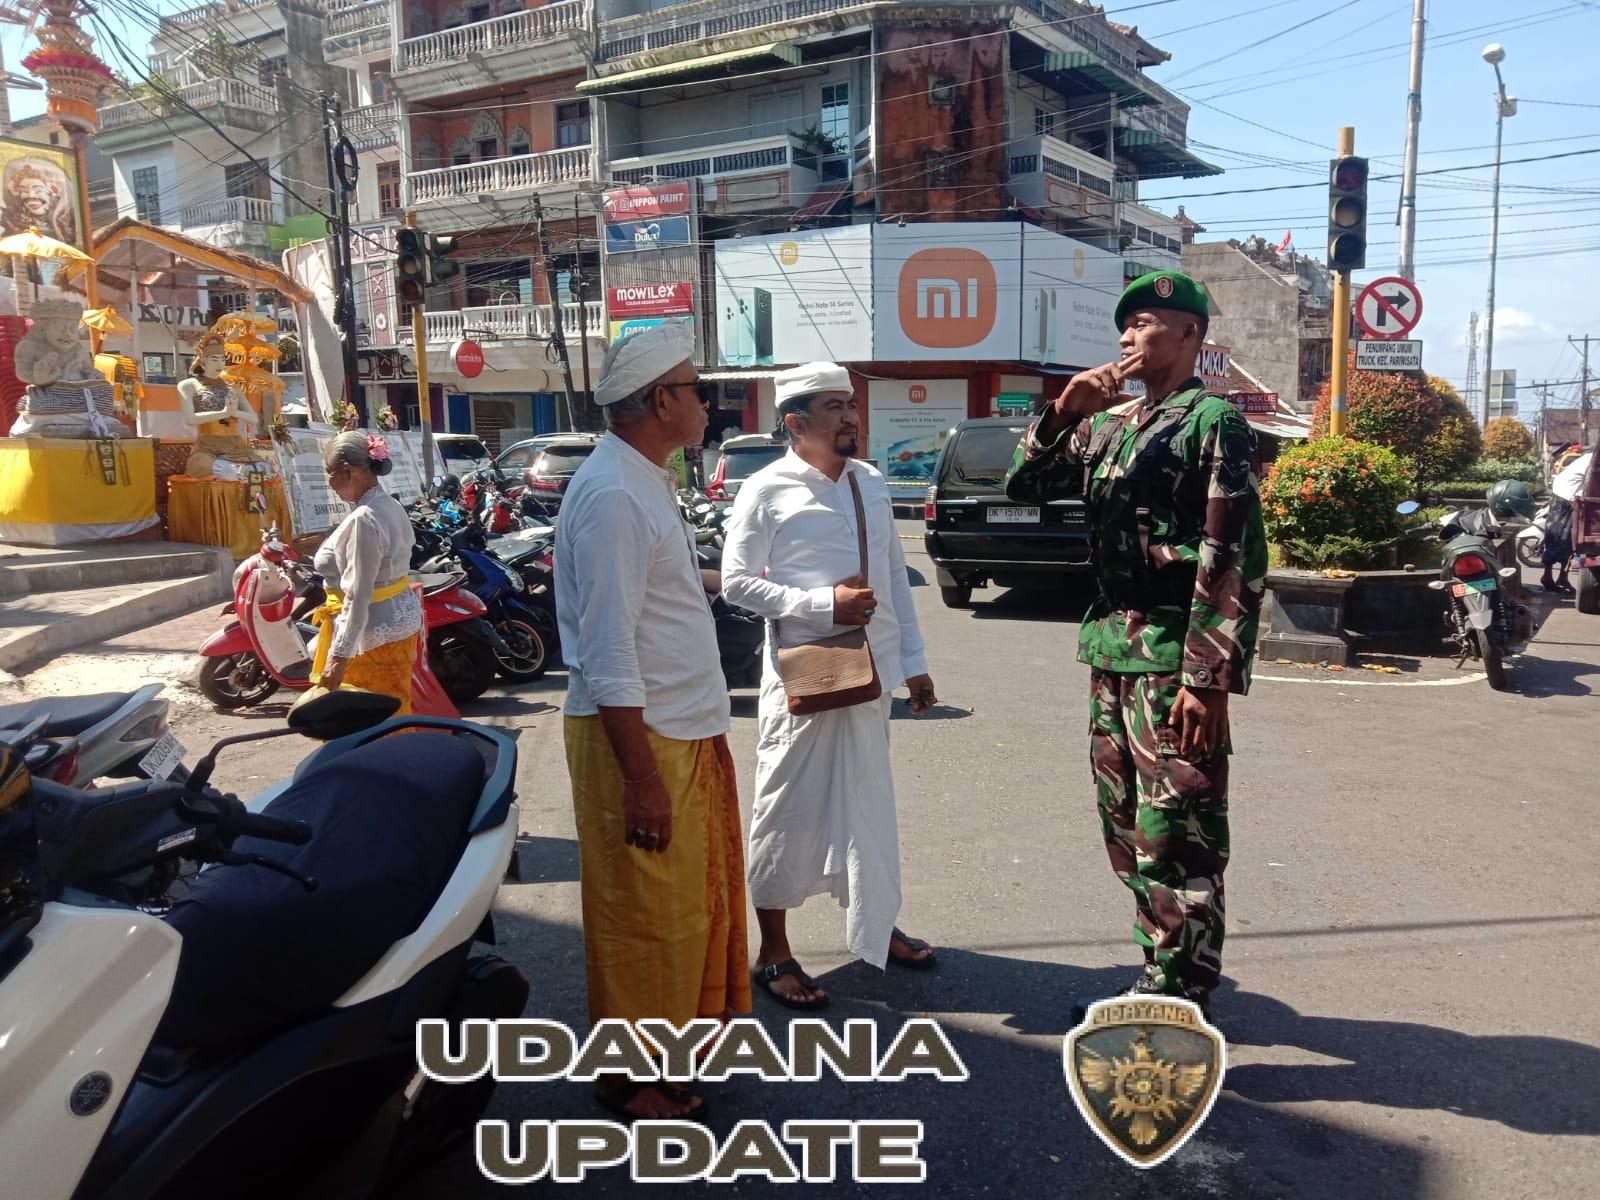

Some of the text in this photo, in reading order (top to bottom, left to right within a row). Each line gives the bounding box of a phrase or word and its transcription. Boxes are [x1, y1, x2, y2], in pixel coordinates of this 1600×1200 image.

[630, 193, 684, 208] NIPPON PAINT
[1366, 343, 1413, 354] PENUMPANG UMUM
[1202, 349, 1230, 378] MIXUE
[1390, 355, 1419, 366] PARIWISATA
[1247, 394, 1277, 403] MIXUE
